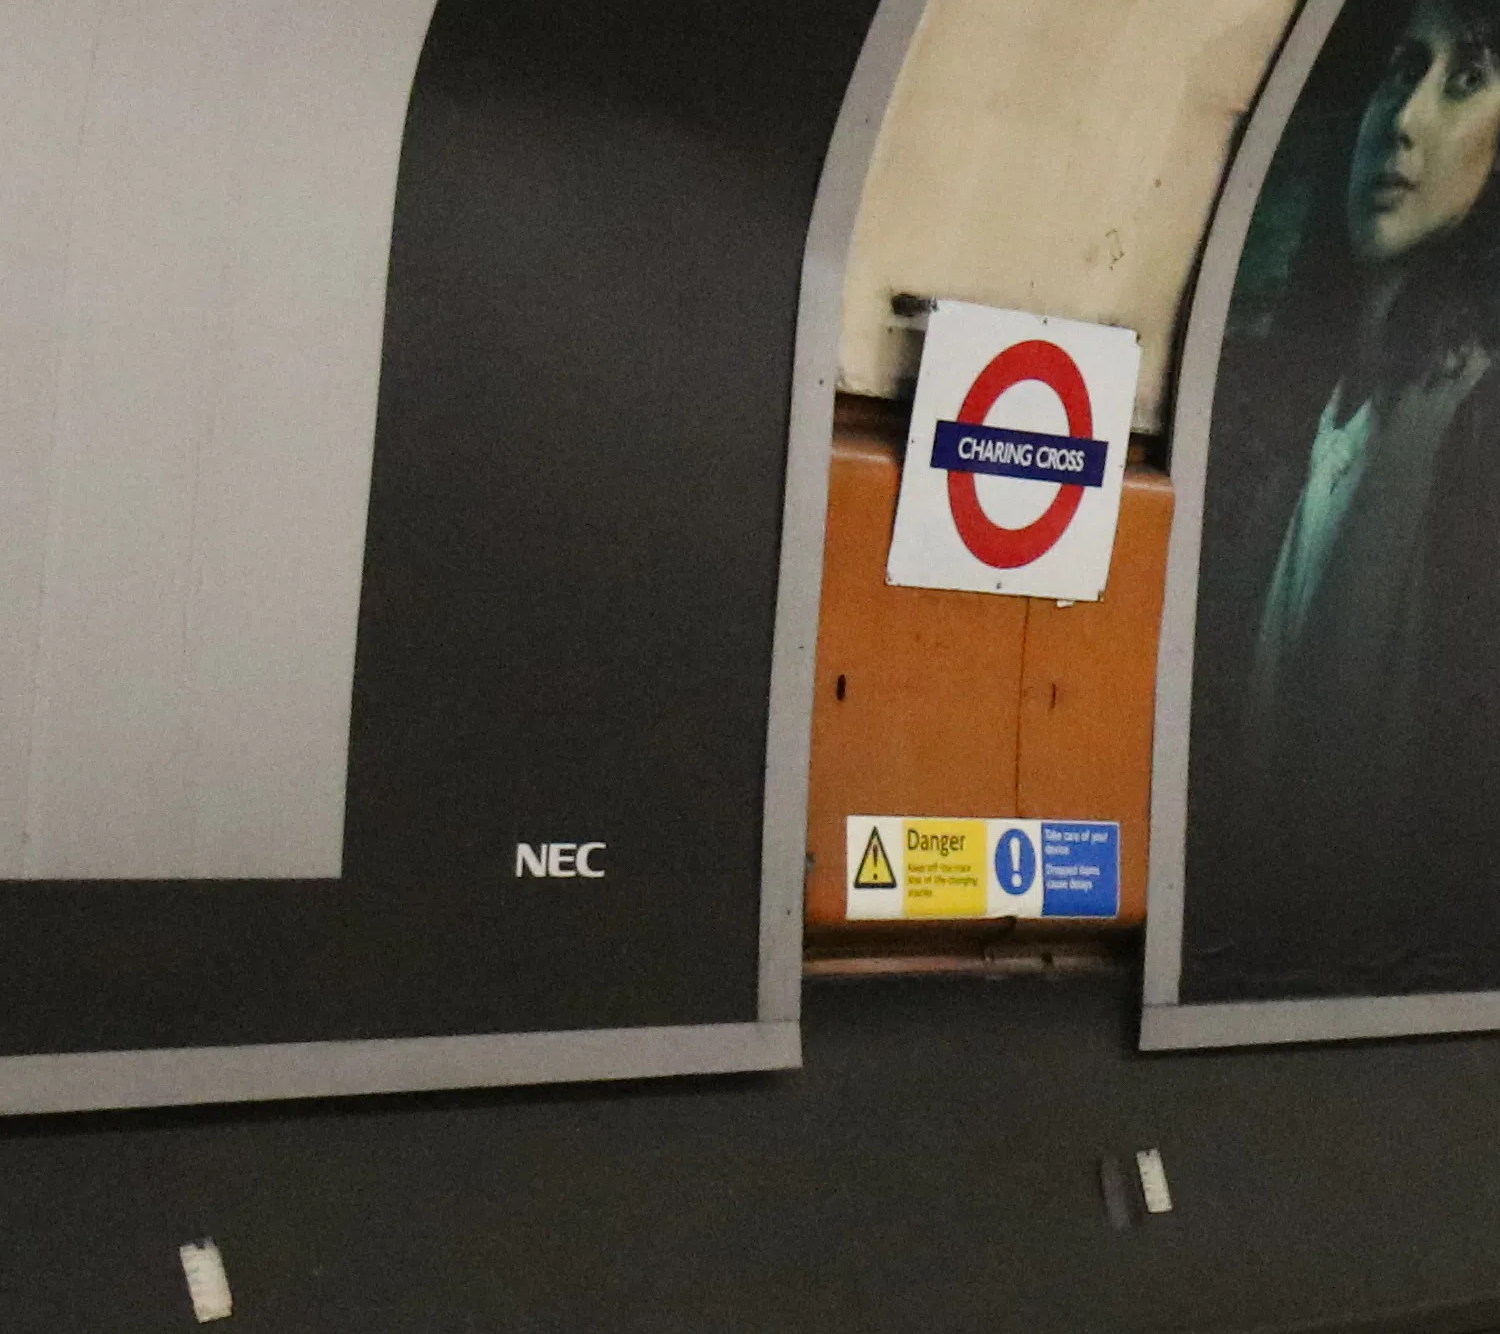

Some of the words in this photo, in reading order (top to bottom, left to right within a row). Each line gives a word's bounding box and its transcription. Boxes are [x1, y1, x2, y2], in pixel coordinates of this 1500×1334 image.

[957, 436, 1034, 467] CHARING
[1035, 445, 1086, 472] CROSS
[514, 841, 607, 879] NEC
[906, 828, 967, 858] Danger
